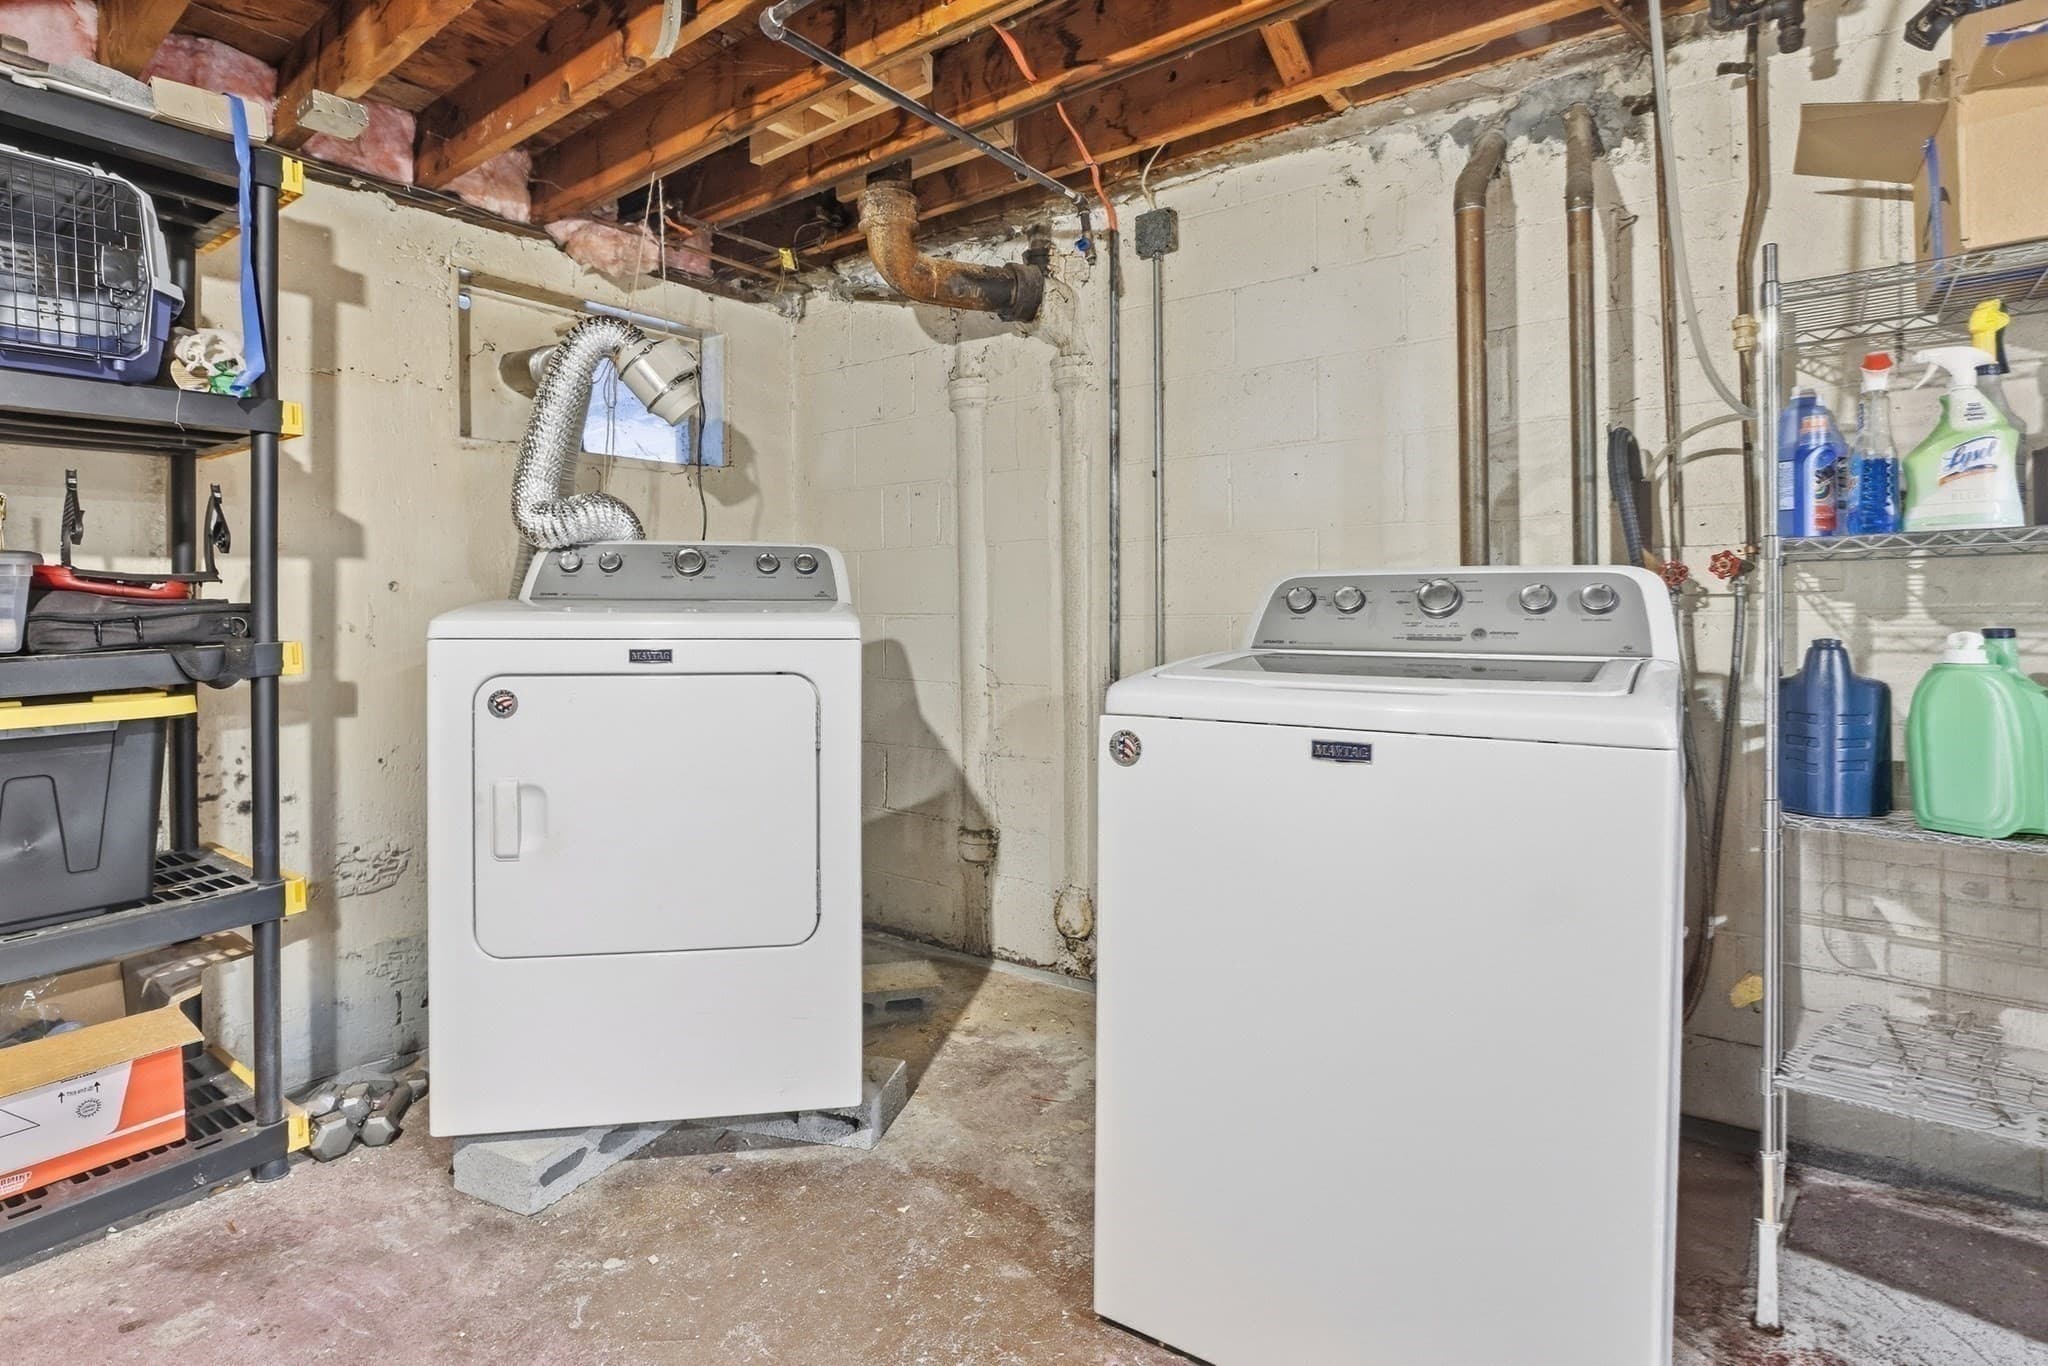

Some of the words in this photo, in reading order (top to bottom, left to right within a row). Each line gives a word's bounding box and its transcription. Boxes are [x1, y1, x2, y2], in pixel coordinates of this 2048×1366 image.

[1943, 440, 1998, 472] Lysol
[631, 651, 670, 660] MAYTAG
[1314, 744, 1369, 758] MAYTAG
